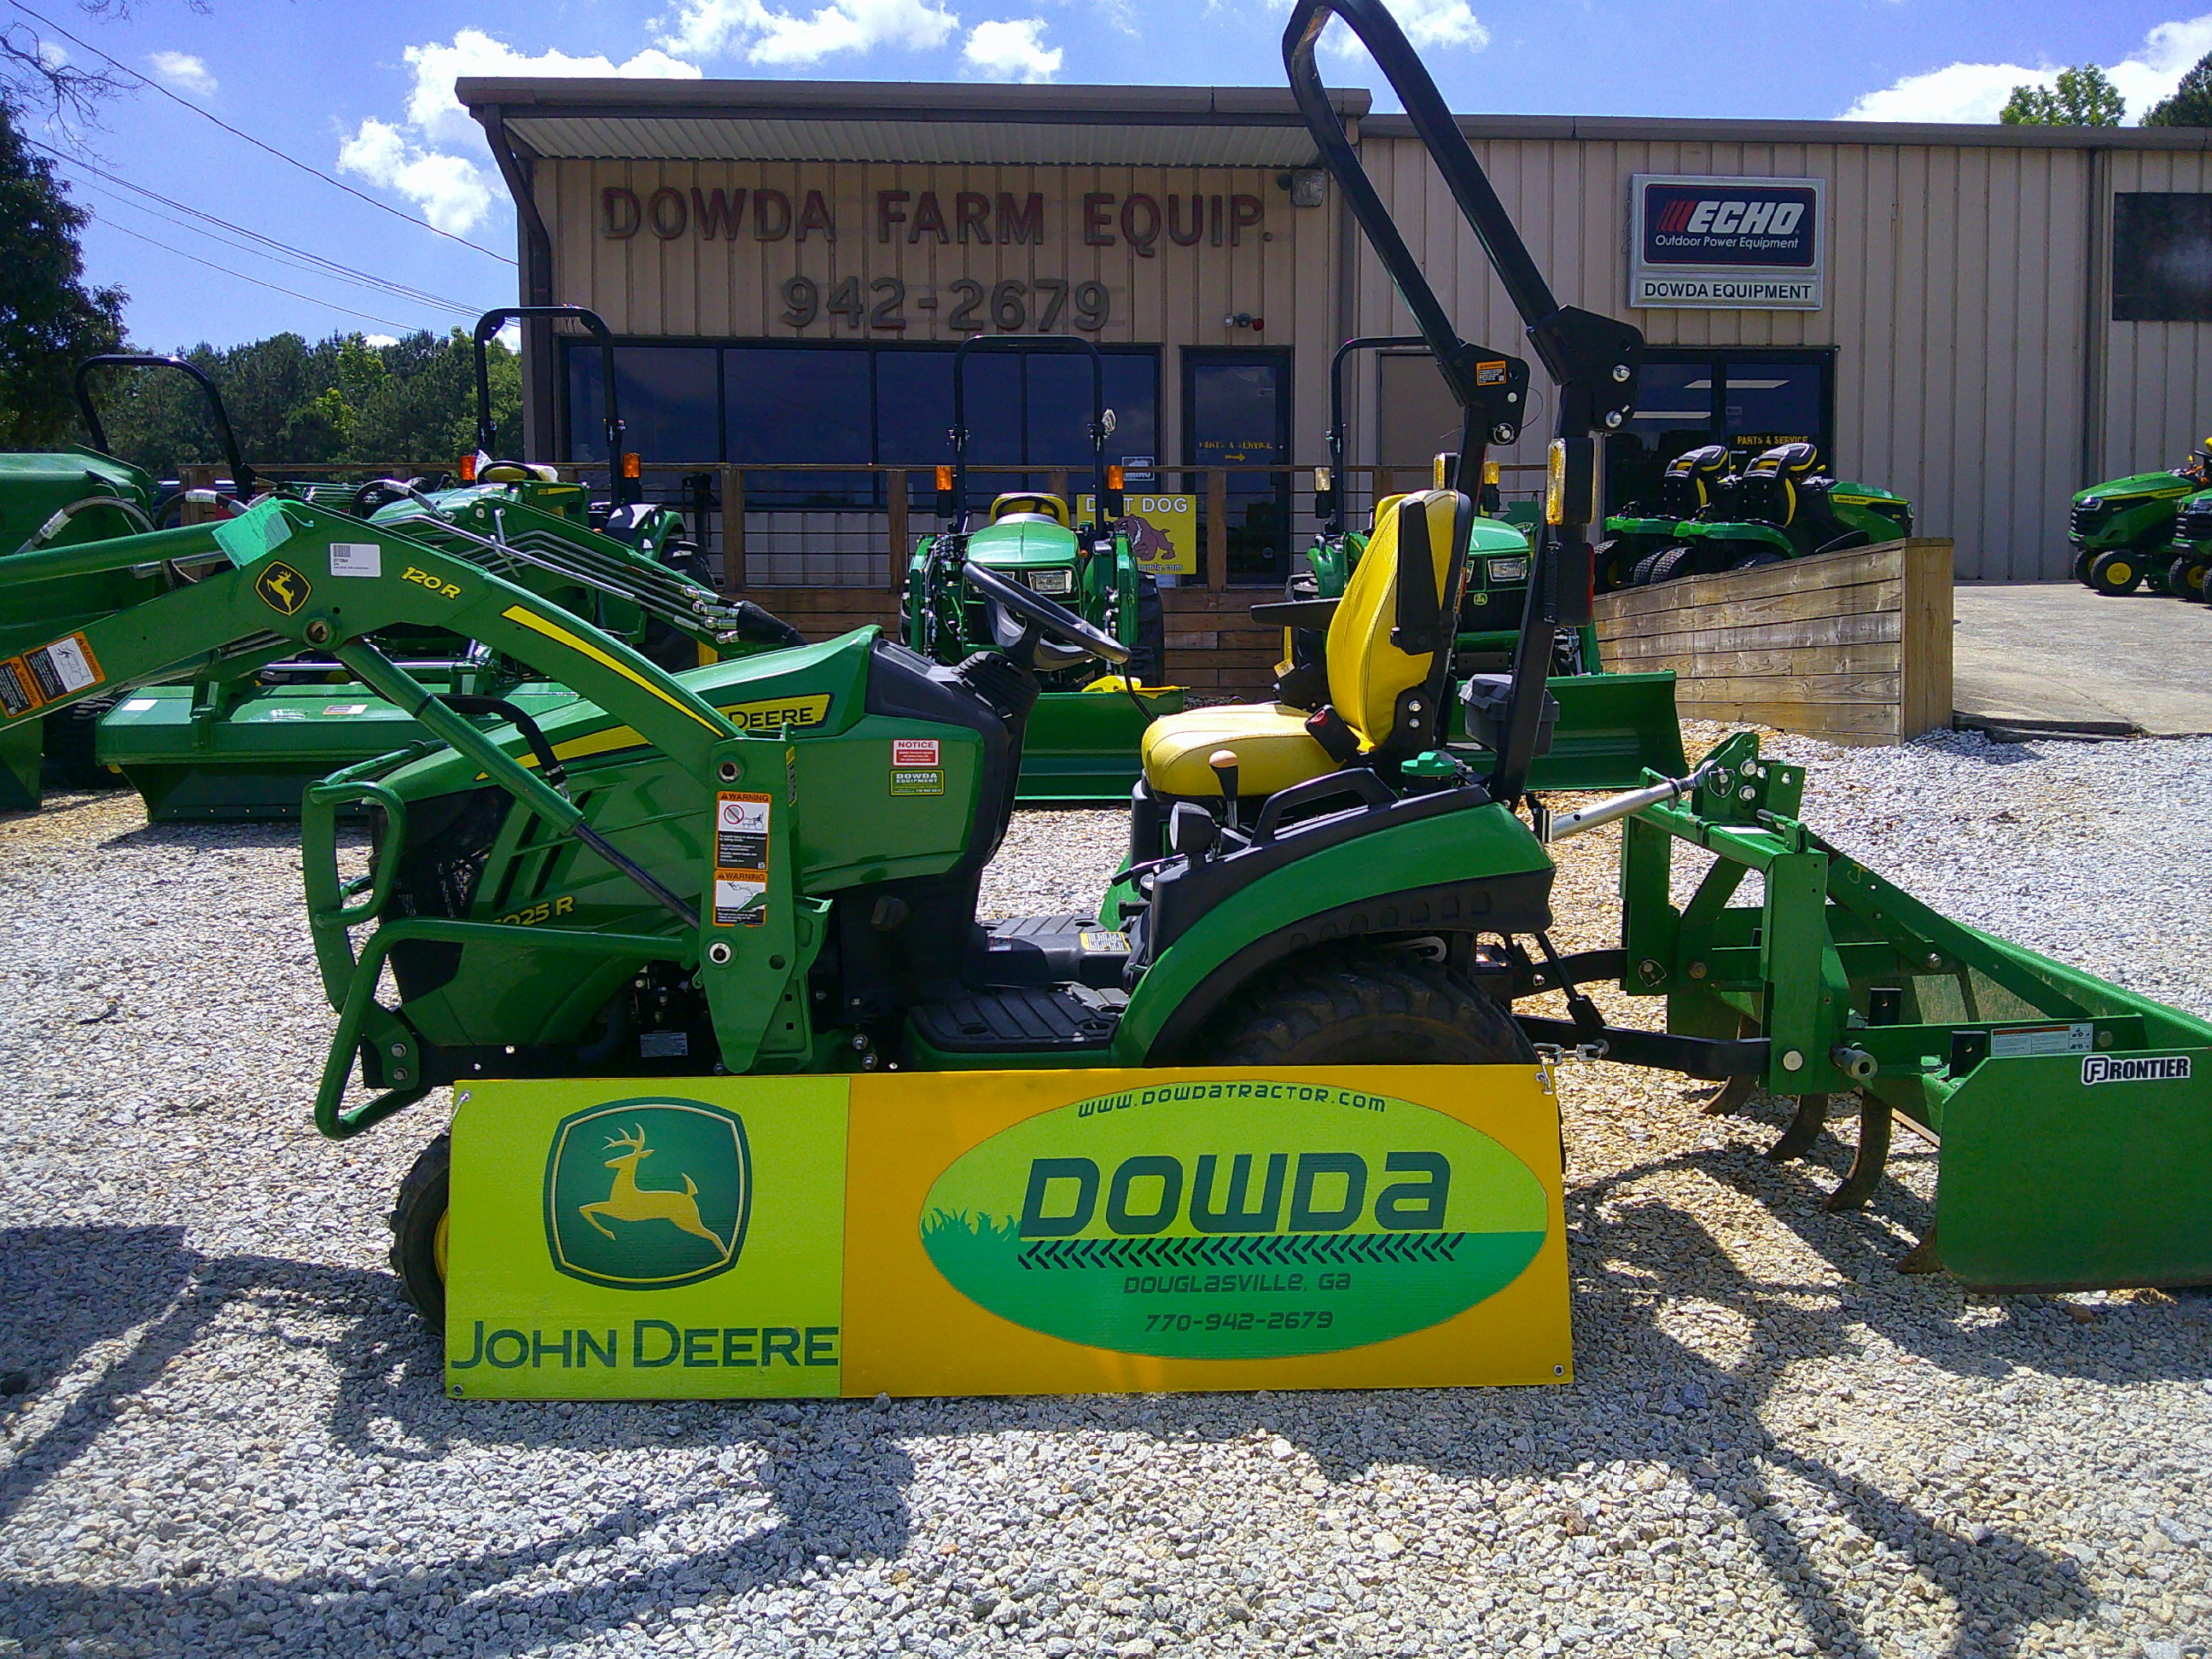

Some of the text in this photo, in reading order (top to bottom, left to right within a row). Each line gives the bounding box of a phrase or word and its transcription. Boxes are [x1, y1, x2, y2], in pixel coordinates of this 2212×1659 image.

[602, 187, 1274, 258] DOWDA FARM EQUIP.
[1686, 201, 1805, 235] ECHO
[1655, 234, 1799, 250] Outdoor Power Equipment
[1644, 282, 1812, 299] DOWDA EQUIPMENT
[781, 276, 1110, 331] 942-2679
[1737, 435, 1763, 445] PARTS
[1773, 435, 1808, 445] SERVICE
[1086, 498, 1188, 513] DT DOG
[728, 707, 813, 729] DEERE
[729, 793, 768, 801] WARNING
[726, 872, 765, 881] WARNING
[2083, 1057, 2189, 1083] FRONTIER
[1144, 1311, 1333, 1331] 770-942-2679
[451, 1319, 839, 1369] JOHN DEERE
